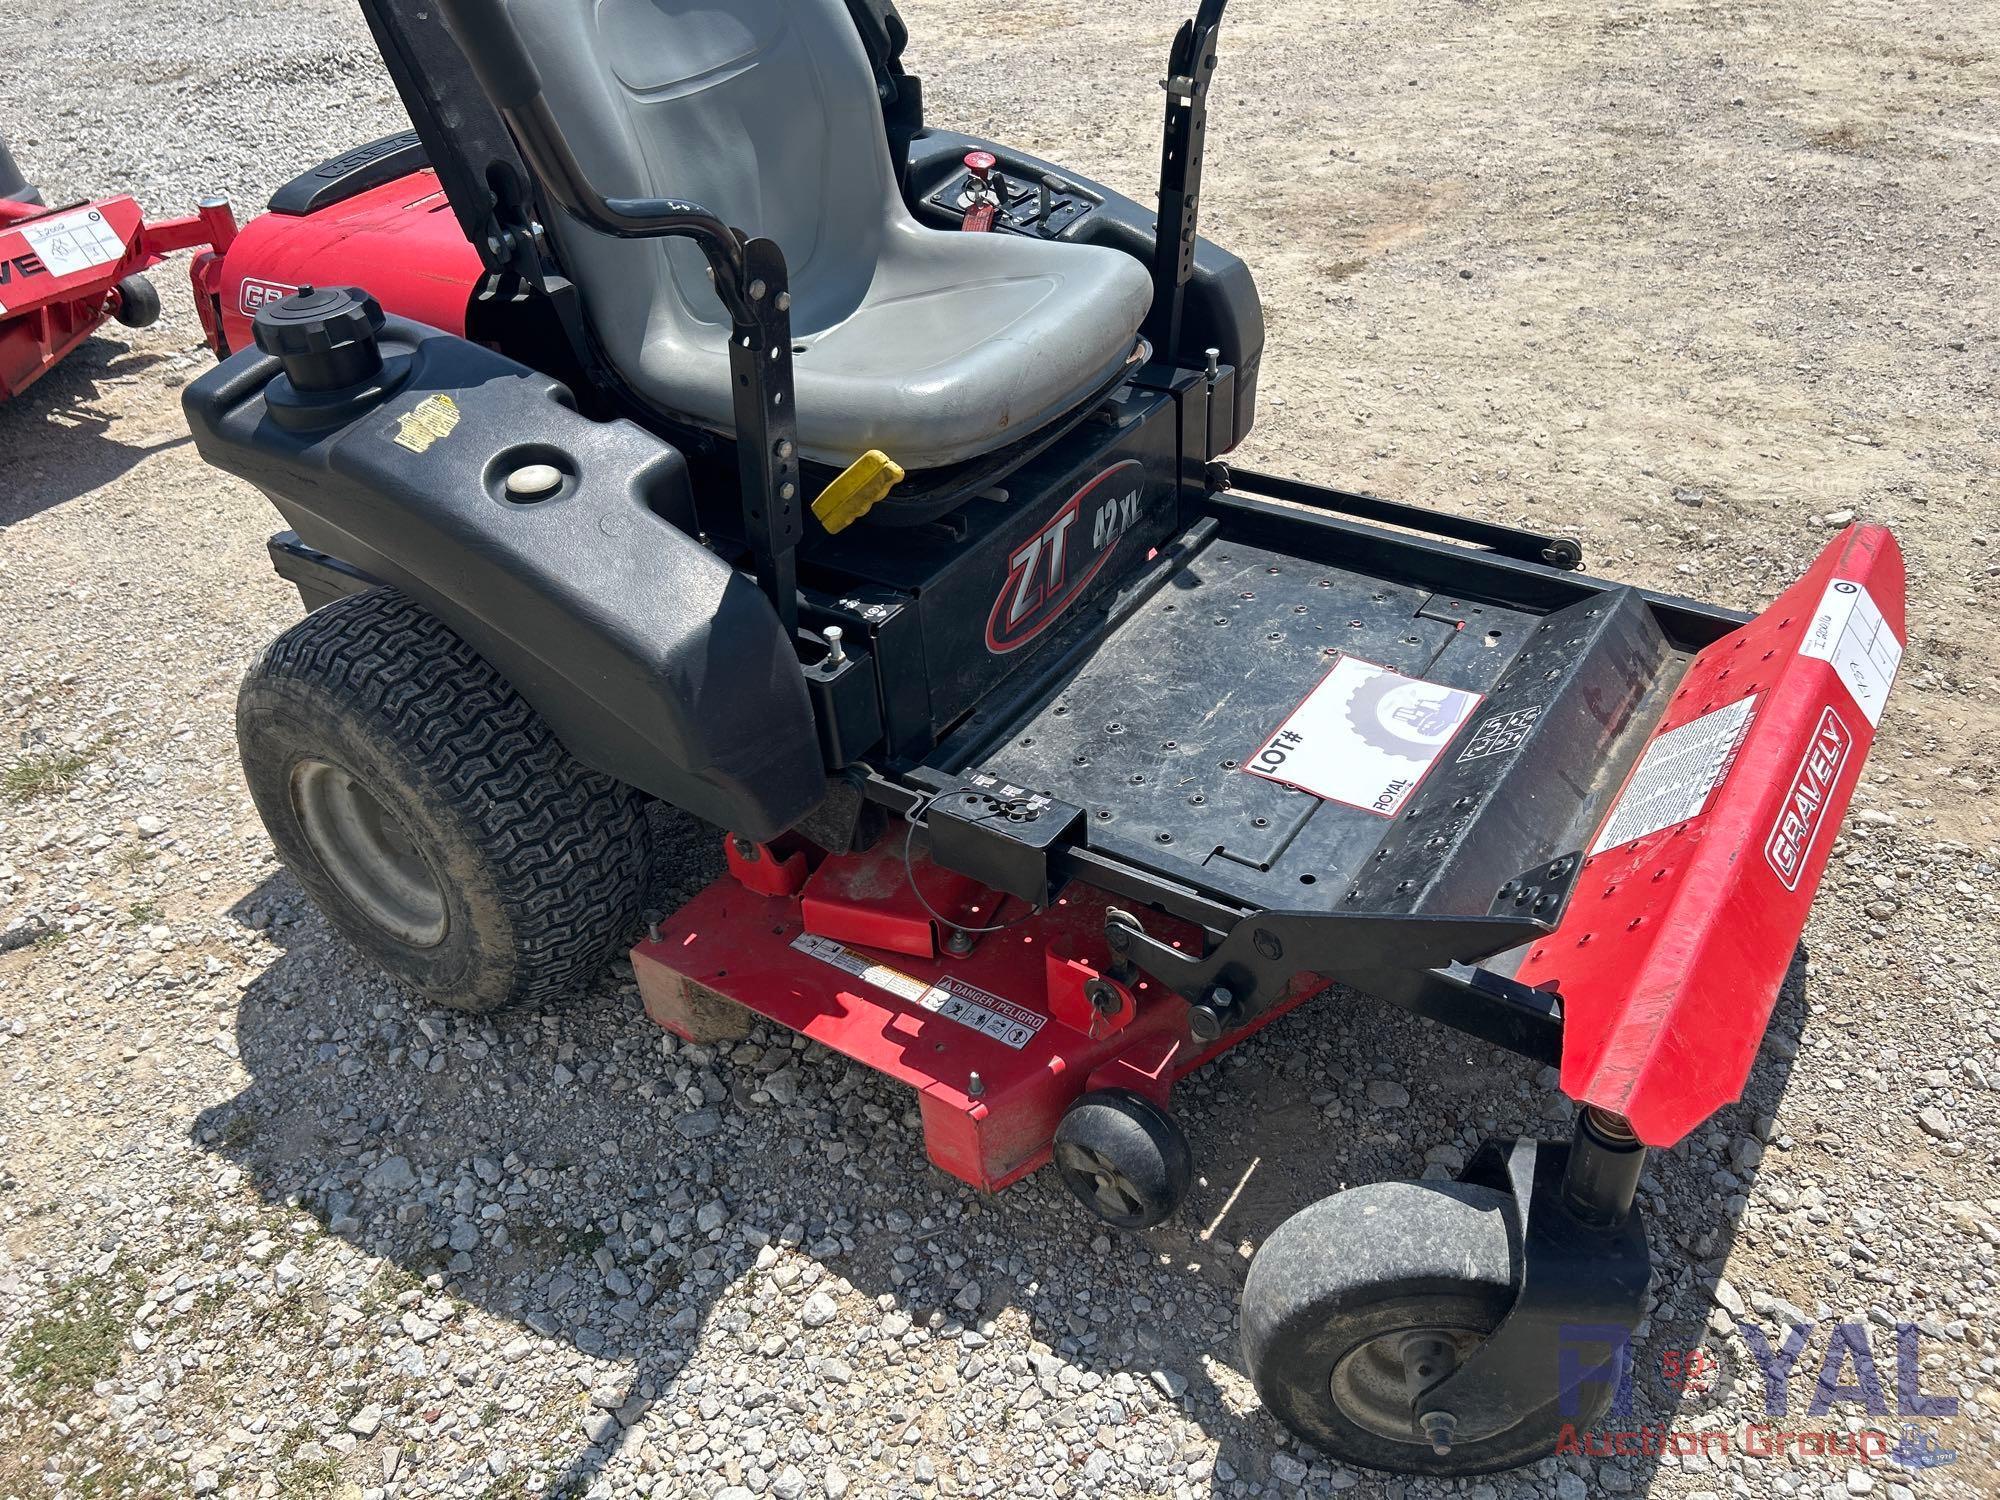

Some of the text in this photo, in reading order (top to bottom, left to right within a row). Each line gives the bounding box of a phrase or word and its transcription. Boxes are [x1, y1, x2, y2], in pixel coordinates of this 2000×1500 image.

[1011, 488, 1144, 625] ZT 42 XL
[1251, 730, 1304, 774] LOT#
[1372, 777, 1408, 811] ROYAL
[1772, 714, 1843, 877] GRAVELY
